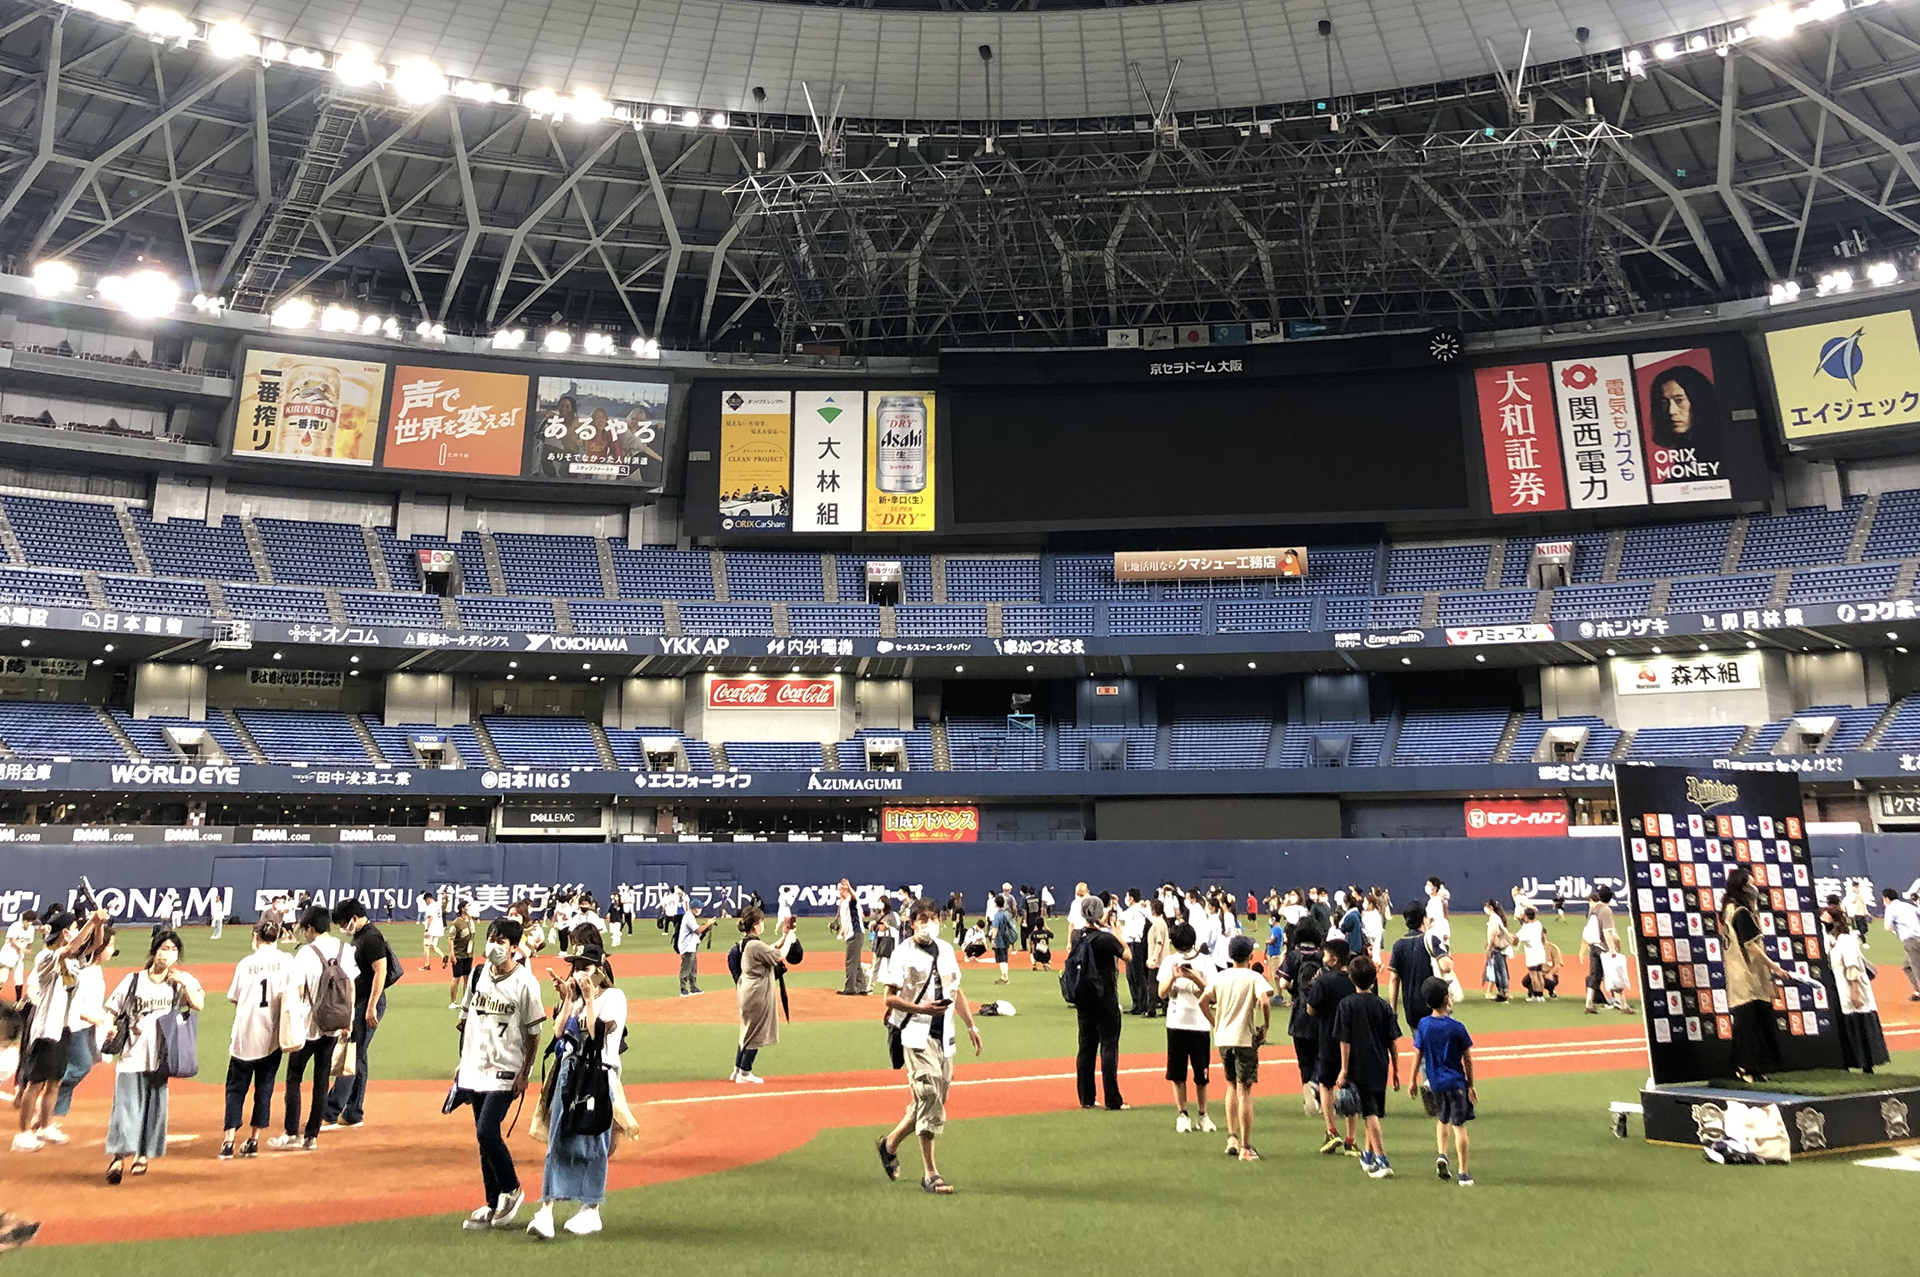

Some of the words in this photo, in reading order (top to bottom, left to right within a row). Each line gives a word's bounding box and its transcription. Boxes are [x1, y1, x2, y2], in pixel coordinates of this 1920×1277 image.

[1150, 359, 1243, 376] 京セラドーム大阪
[398, 380, 460, 419] 声で
[252, 369, 282, 451] 一番搾り
[285, 405, 312, 415] KIRIN
[314, 405, 336, 419] BEER
[1790, 391, 1920, 427] エイジェック
[289, 419, 328, 432] 一番搾り
[395, 405, 523, 445] 世界を変える!
[544, 415, 656, 443] あるやろ
[1605, 378, 1636, 482] 電気もガスも
[881, 429, 922, 447] Asahi
[1495, 370, 1546, 507] 大和証券
[896, 451, 907, 459] 生
[1568, 396, 1608, 502] 関西電力
[1654, 448, 1697, 464] ORIX
[1656, 461, 1720, 480] MONEY
[816, 437, 841, 526] 大林組
[735, 520, 754, 528] ORIX
[755, 519, 786, 528] CarShare
[1537, 544, 1573, 555] KIRIN
[1121, 561, 1176, 572] 土地活用なら
[1176, 555, 1276, 571] クマシュー工務店
[322, 626, 380, 645] オノコム
[1596, 618, 1669, 638] ホシザキ
[550, 636, 628, 652] YOKOHAMA
[659, 637, 700, 655] YKK
[702, 637, 730, 655] AP
[787, 639, 854, 655] 内外電機
[1003, 639, 1085, 655] 串かつだるま
[1368, 633, 1420, 645] Energywith
[1671, 662, 1741, 686] 森本組
[1898, 753, 1920, 772] 北
[648, 774, 752, 788] エスフォーライフ
[807, 773, 902, 791] AZUMAGUMI
[66, 886, 234, 919] KONAMI
[617, 882, 753, 911] 新成ラスト
[259, 978, 268, 1008] 1
[497, 1022, 509, 1038] 7
